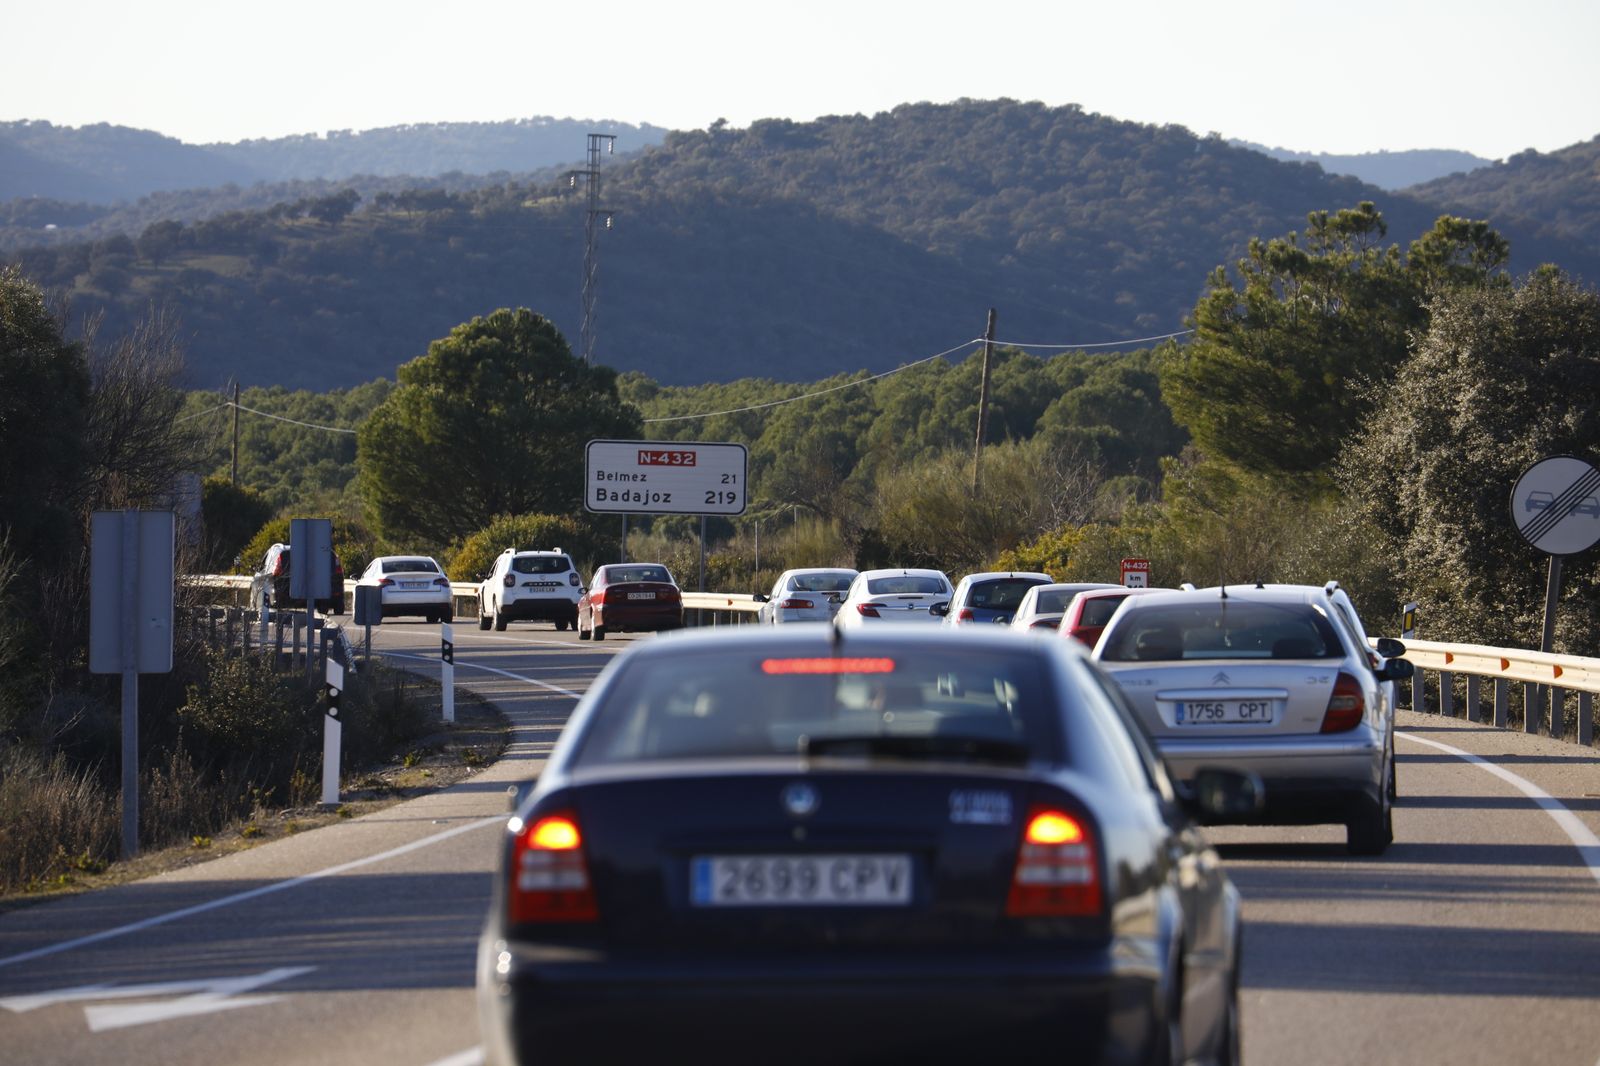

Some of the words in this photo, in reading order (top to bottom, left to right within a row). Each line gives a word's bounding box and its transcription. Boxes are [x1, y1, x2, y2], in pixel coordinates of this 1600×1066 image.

[640, 452, 694, 465] N-432
[597, 470, 647, 482] Belmez
[721, 473, 736, 484] 21
[596, 488, 672, 505] Badajoz
[704, 491, 736, 504] 219
[1187, 703, 1225, 719] 1756
[1239, 703, 1269, 719] CPT
[720, 858, 820, 897] 2699
[829, 857, 907, 897] CPV
